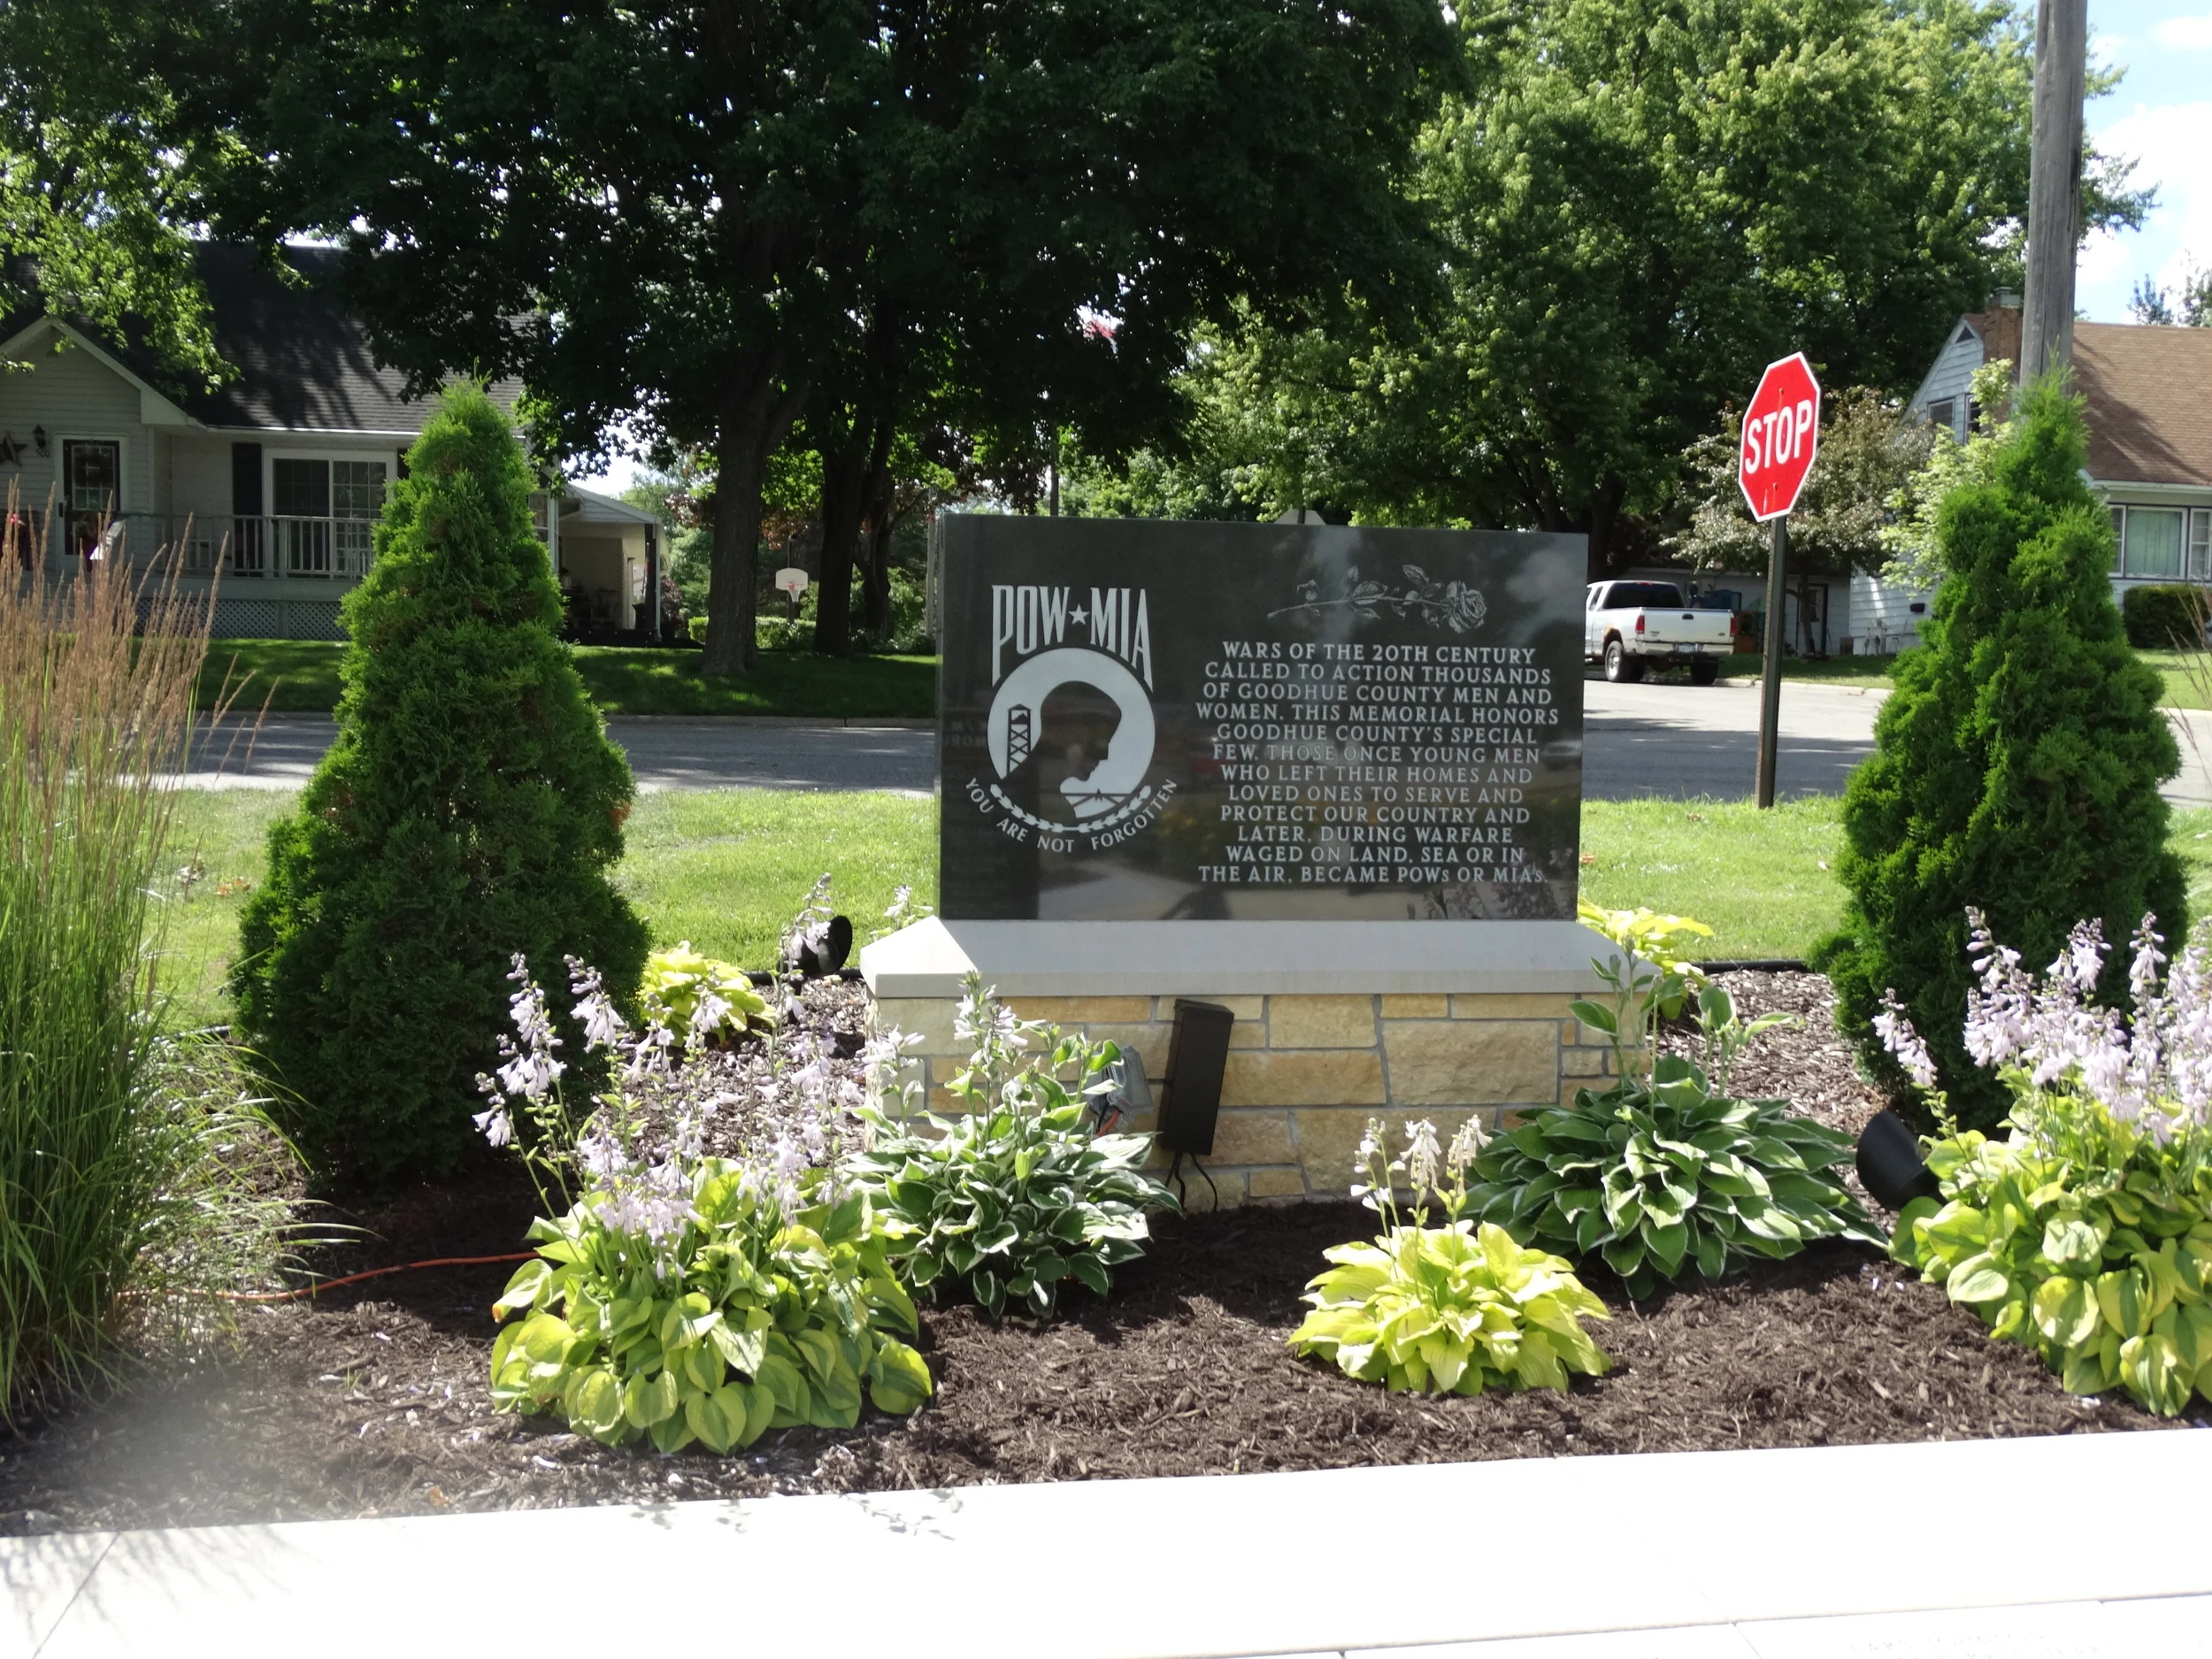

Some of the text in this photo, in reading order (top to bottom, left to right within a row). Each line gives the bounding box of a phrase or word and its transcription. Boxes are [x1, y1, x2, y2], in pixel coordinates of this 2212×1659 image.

[1745, 399, 1812, 474] STOP
[991, 585, 1153, 693] POW MIA
[1223, 641, 1535, 664] WARS OF THE 20TH CENTURY
[1205, 662, 1550, 684] CALLED TO ACTION THOUSANDS
[1203, 682, 1551, 704] OF GOODHUE COUNTY MEN AND
[1195, 703, 1558, 725] WOMEN. THIS MEMORIAL HONORS
[1217, 724, 1536, 743] GOODHUE COUNTY'S SPECIAL
[1213, 743, 1540, 764] FEW. THOSE ONCE YOUNG MEN
[1221, 764, 1532, 783] WHO LEFT THEIR HOMES AND
[1229, 785, 1523, 803] LOVED ONES TO SERVE AND
[964, 778, 1178, 853] YOU ARE NOT FORGOTTEN
[1221, 805, 1530, 823] PROTECT OUR COUNTRY AND
[1321, 826, 1406, 842] DURING
[1415, 827, 1512, 843] WARFARE
[1225, 846, 1302, 862] WAGED
[1311, 847, 1340, 862] ON
[1421, 847, 1459, 863] SEA
[1466, 847, 1494, 863] OR
[1502, 848, 1523, 864] IN
[1199, 866, 1240, 881] THE
[1302, 866, 1389, 882] BECAME
[1398, 867, 1448, 882] POWs
[1457, 867, 1483, 882] OR
